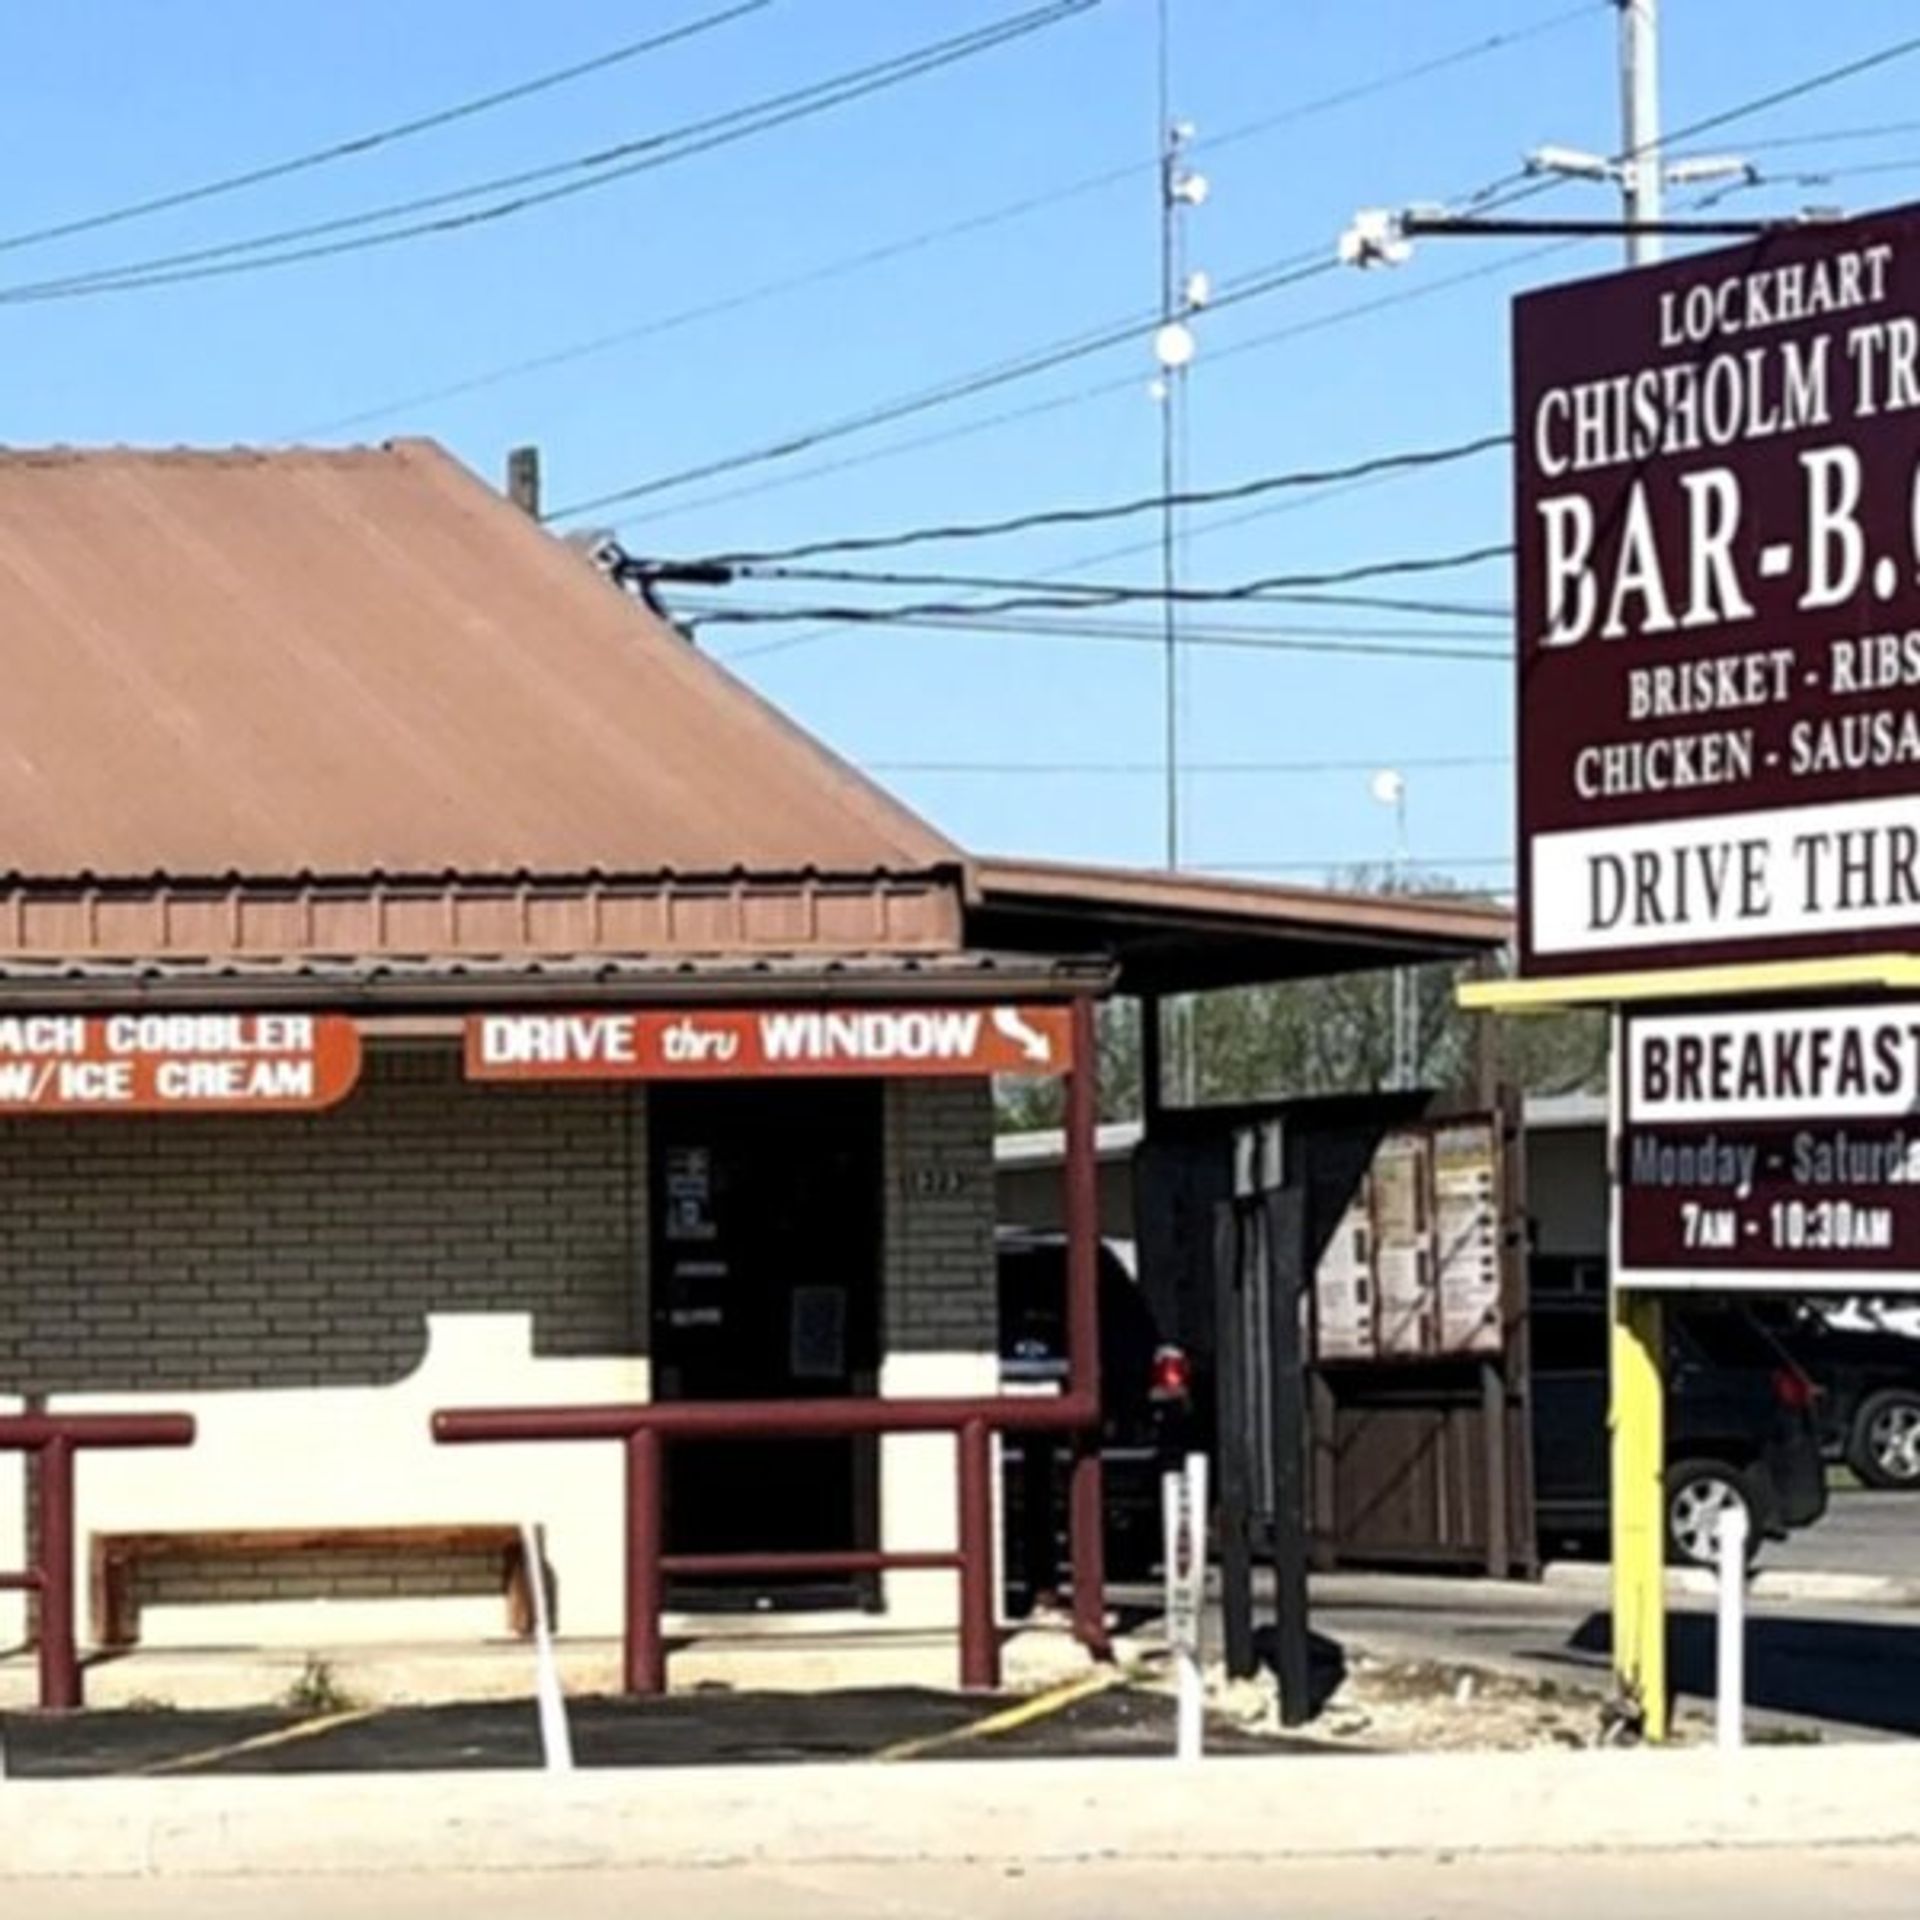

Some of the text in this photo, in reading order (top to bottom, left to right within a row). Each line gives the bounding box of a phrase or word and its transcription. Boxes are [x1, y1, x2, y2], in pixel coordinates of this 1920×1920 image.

[1660, 245, 1892, 347] LOCKHART
[1535, 316, 1920, 476] CHISHOLM TR
[1537, 446, 1920, 647] BAR-B.
[1628, 649, 1795, 720] BRISKET
[1830, 630, 1920, 694] RIBS
[1574, 729, 1754, 798] CHICKEN
[1790, 711, 1920, 775] SAUSA
[1587, 825, 1920, 932] DRIVE THR
[105, 1015, 313, 1053] COBBLER
[481, 1012, 981, 1064] DRIVE thru WINDOW
[0, 1060, 314, 1102] W/ICE CREAM
[1632, 1134, 1757, 1199] Monday
[1682, 1203, 1736, 1248] 7AM
[1771, 1202, 1892, 1249] 10:30AM
